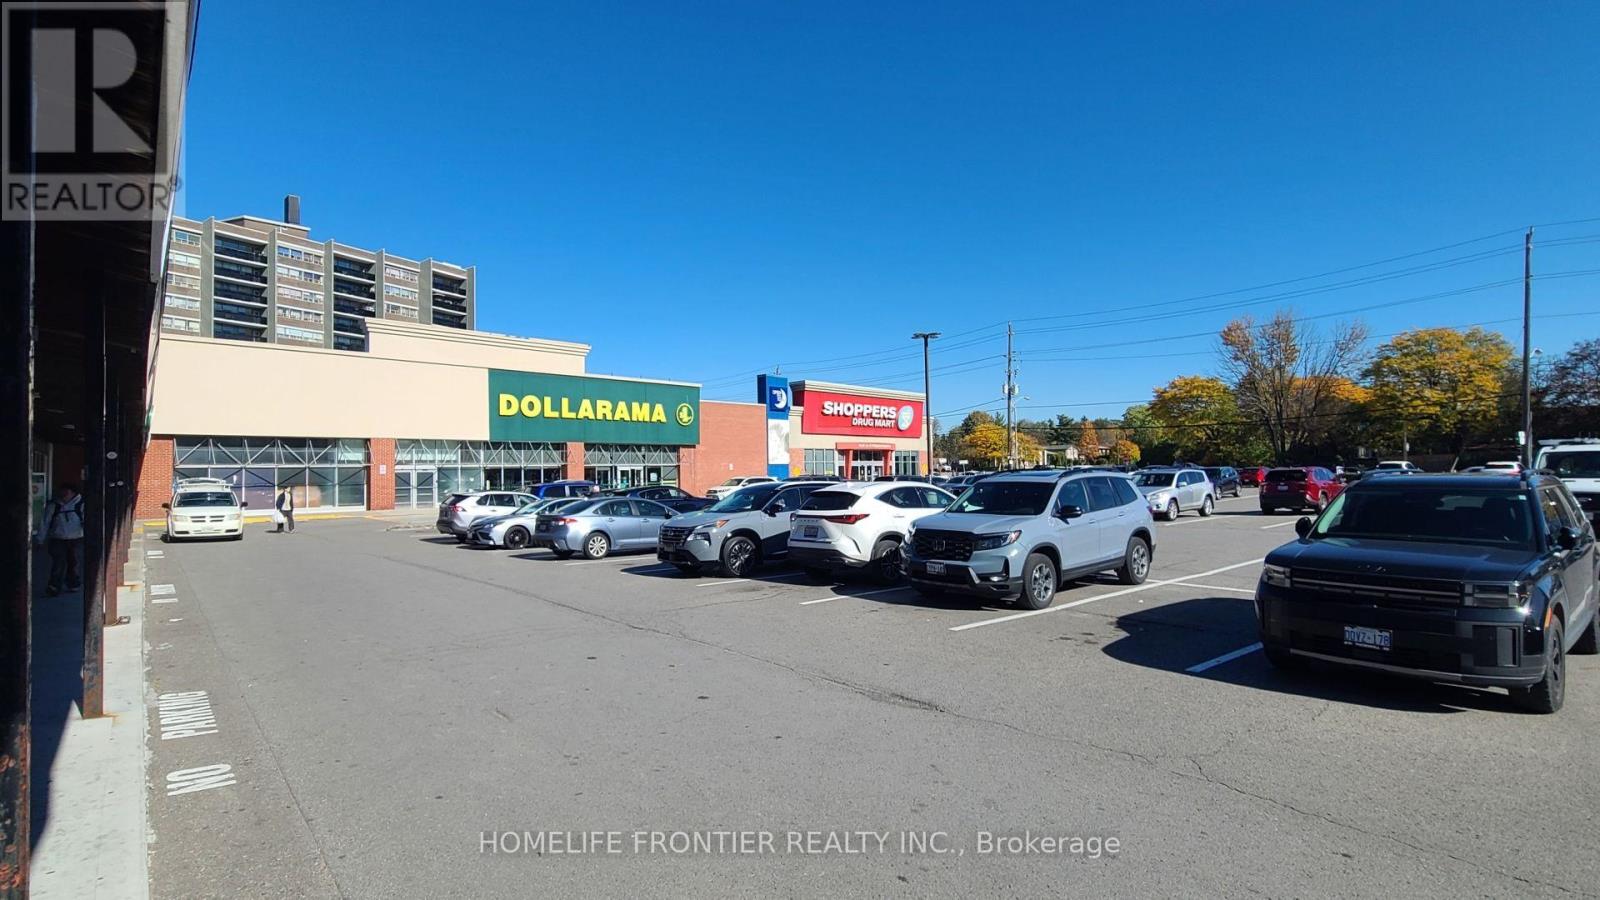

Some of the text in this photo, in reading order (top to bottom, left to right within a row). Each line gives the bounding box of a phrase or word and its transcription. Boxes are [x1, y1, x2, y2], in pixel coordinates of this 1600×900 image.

[499, 393, 667, 424] DOLLARAMA
[822, 400, 897, 419] SHOPPERS
[852, 418, 896, 428] DRUG MART
[159, 690, 237, 797] NO PARKING
